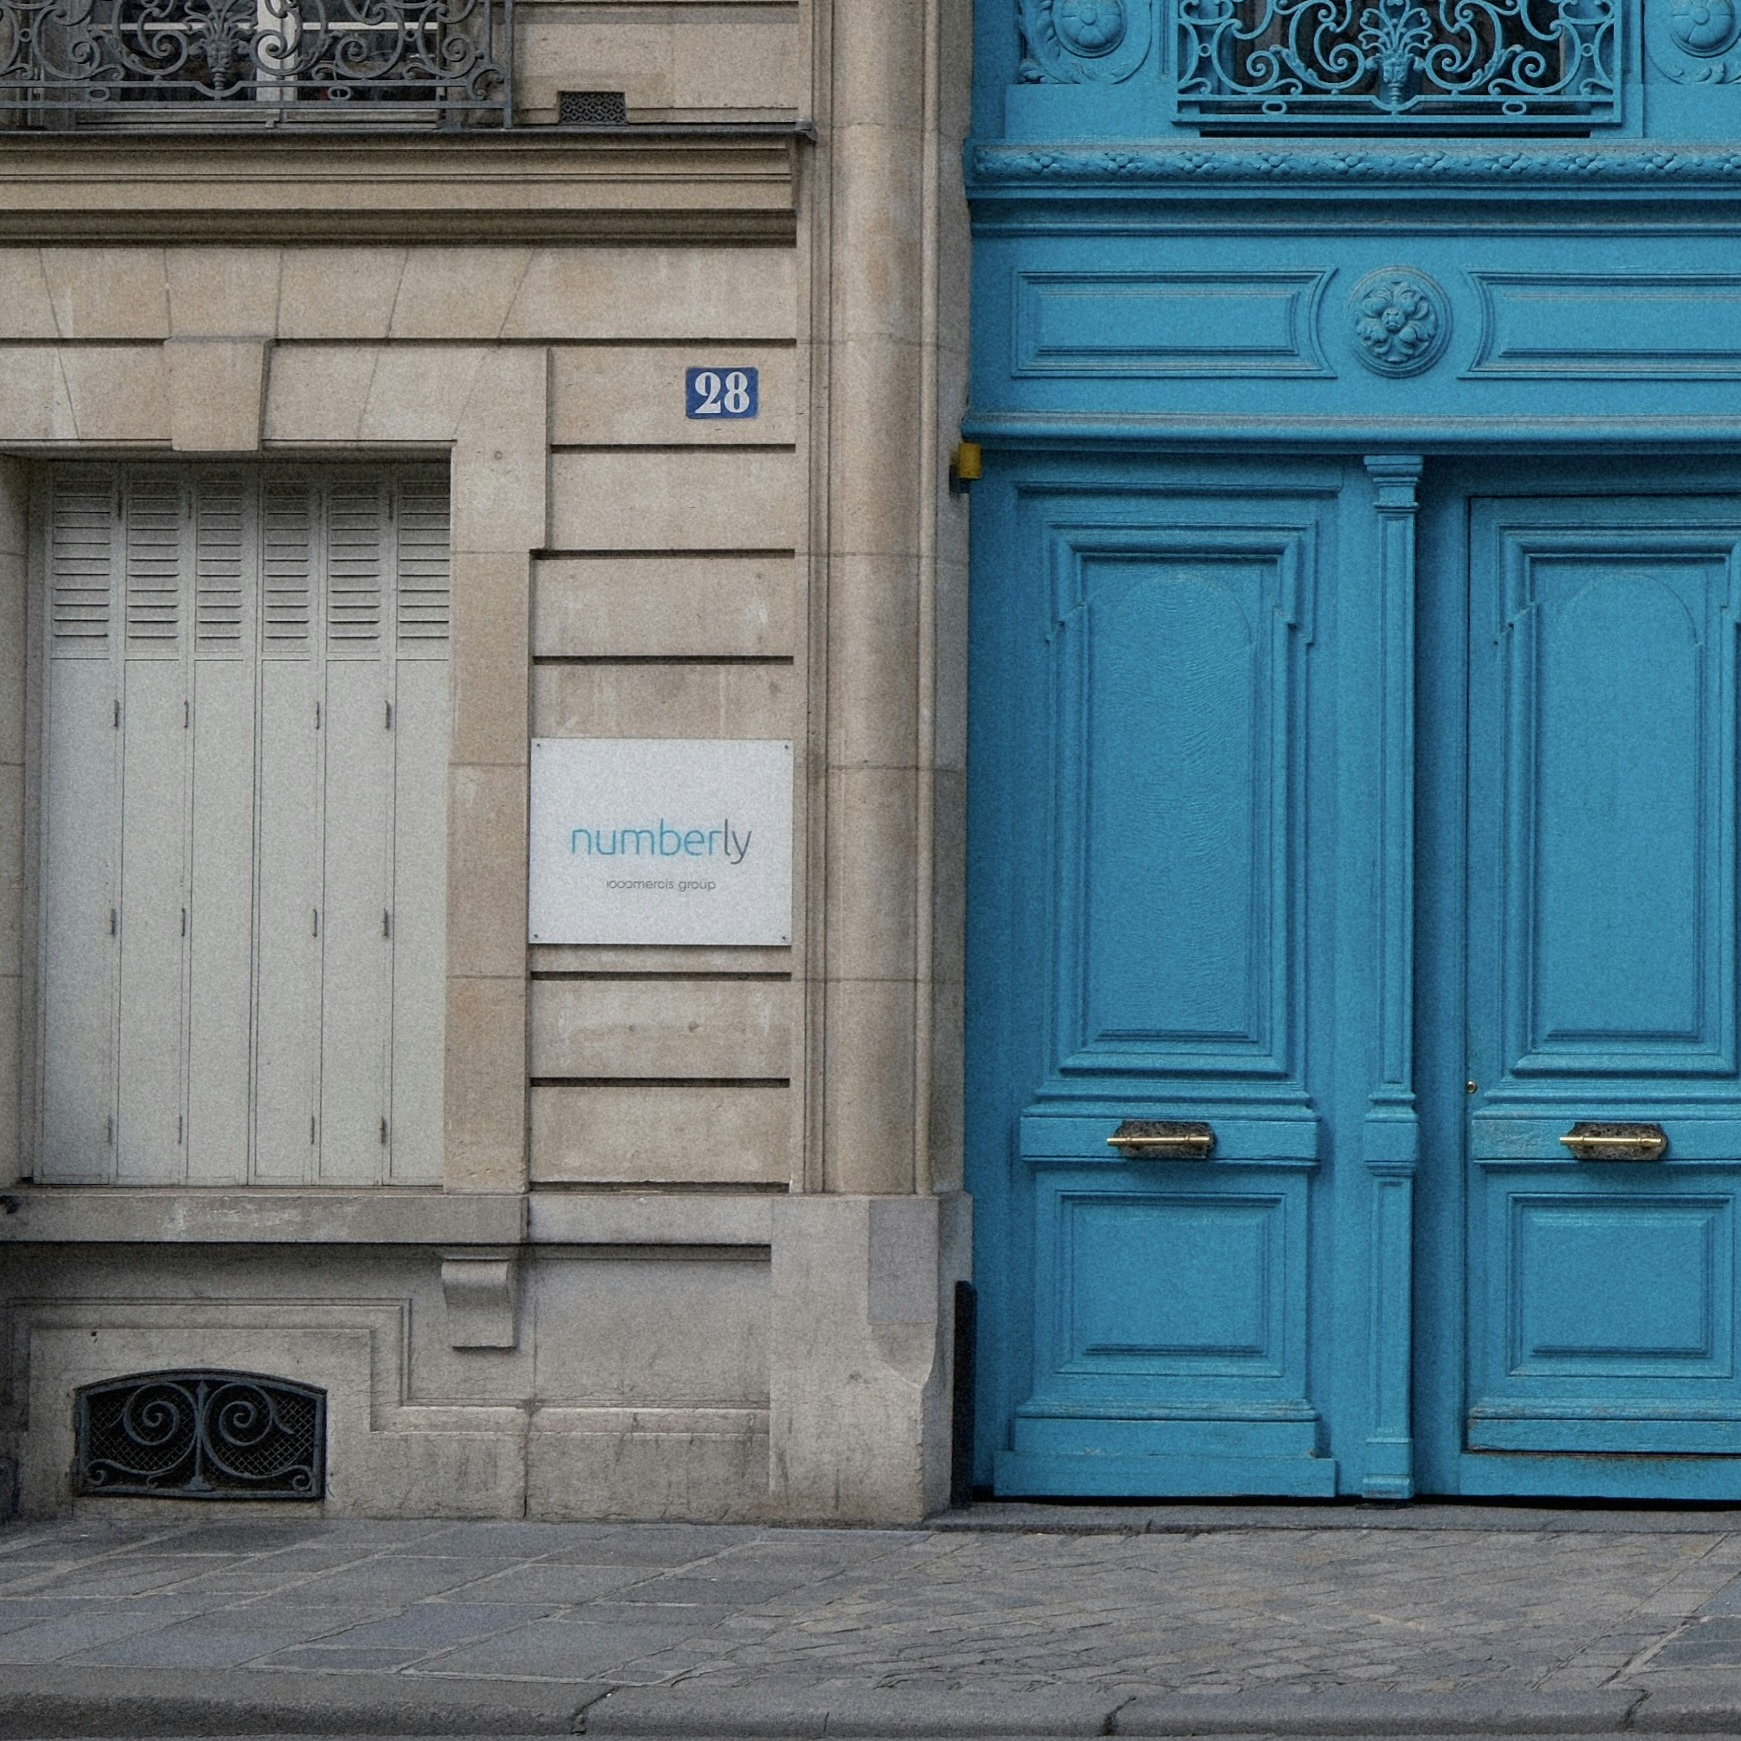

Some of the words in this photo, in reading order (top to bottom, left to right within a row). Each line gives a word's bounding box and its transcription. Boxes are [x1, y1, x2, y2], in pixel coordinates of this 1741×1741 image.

[694, 371, 750, 414] 28
[571, 818, 752, 865] numberly
[678, 880, 717, 892] group
